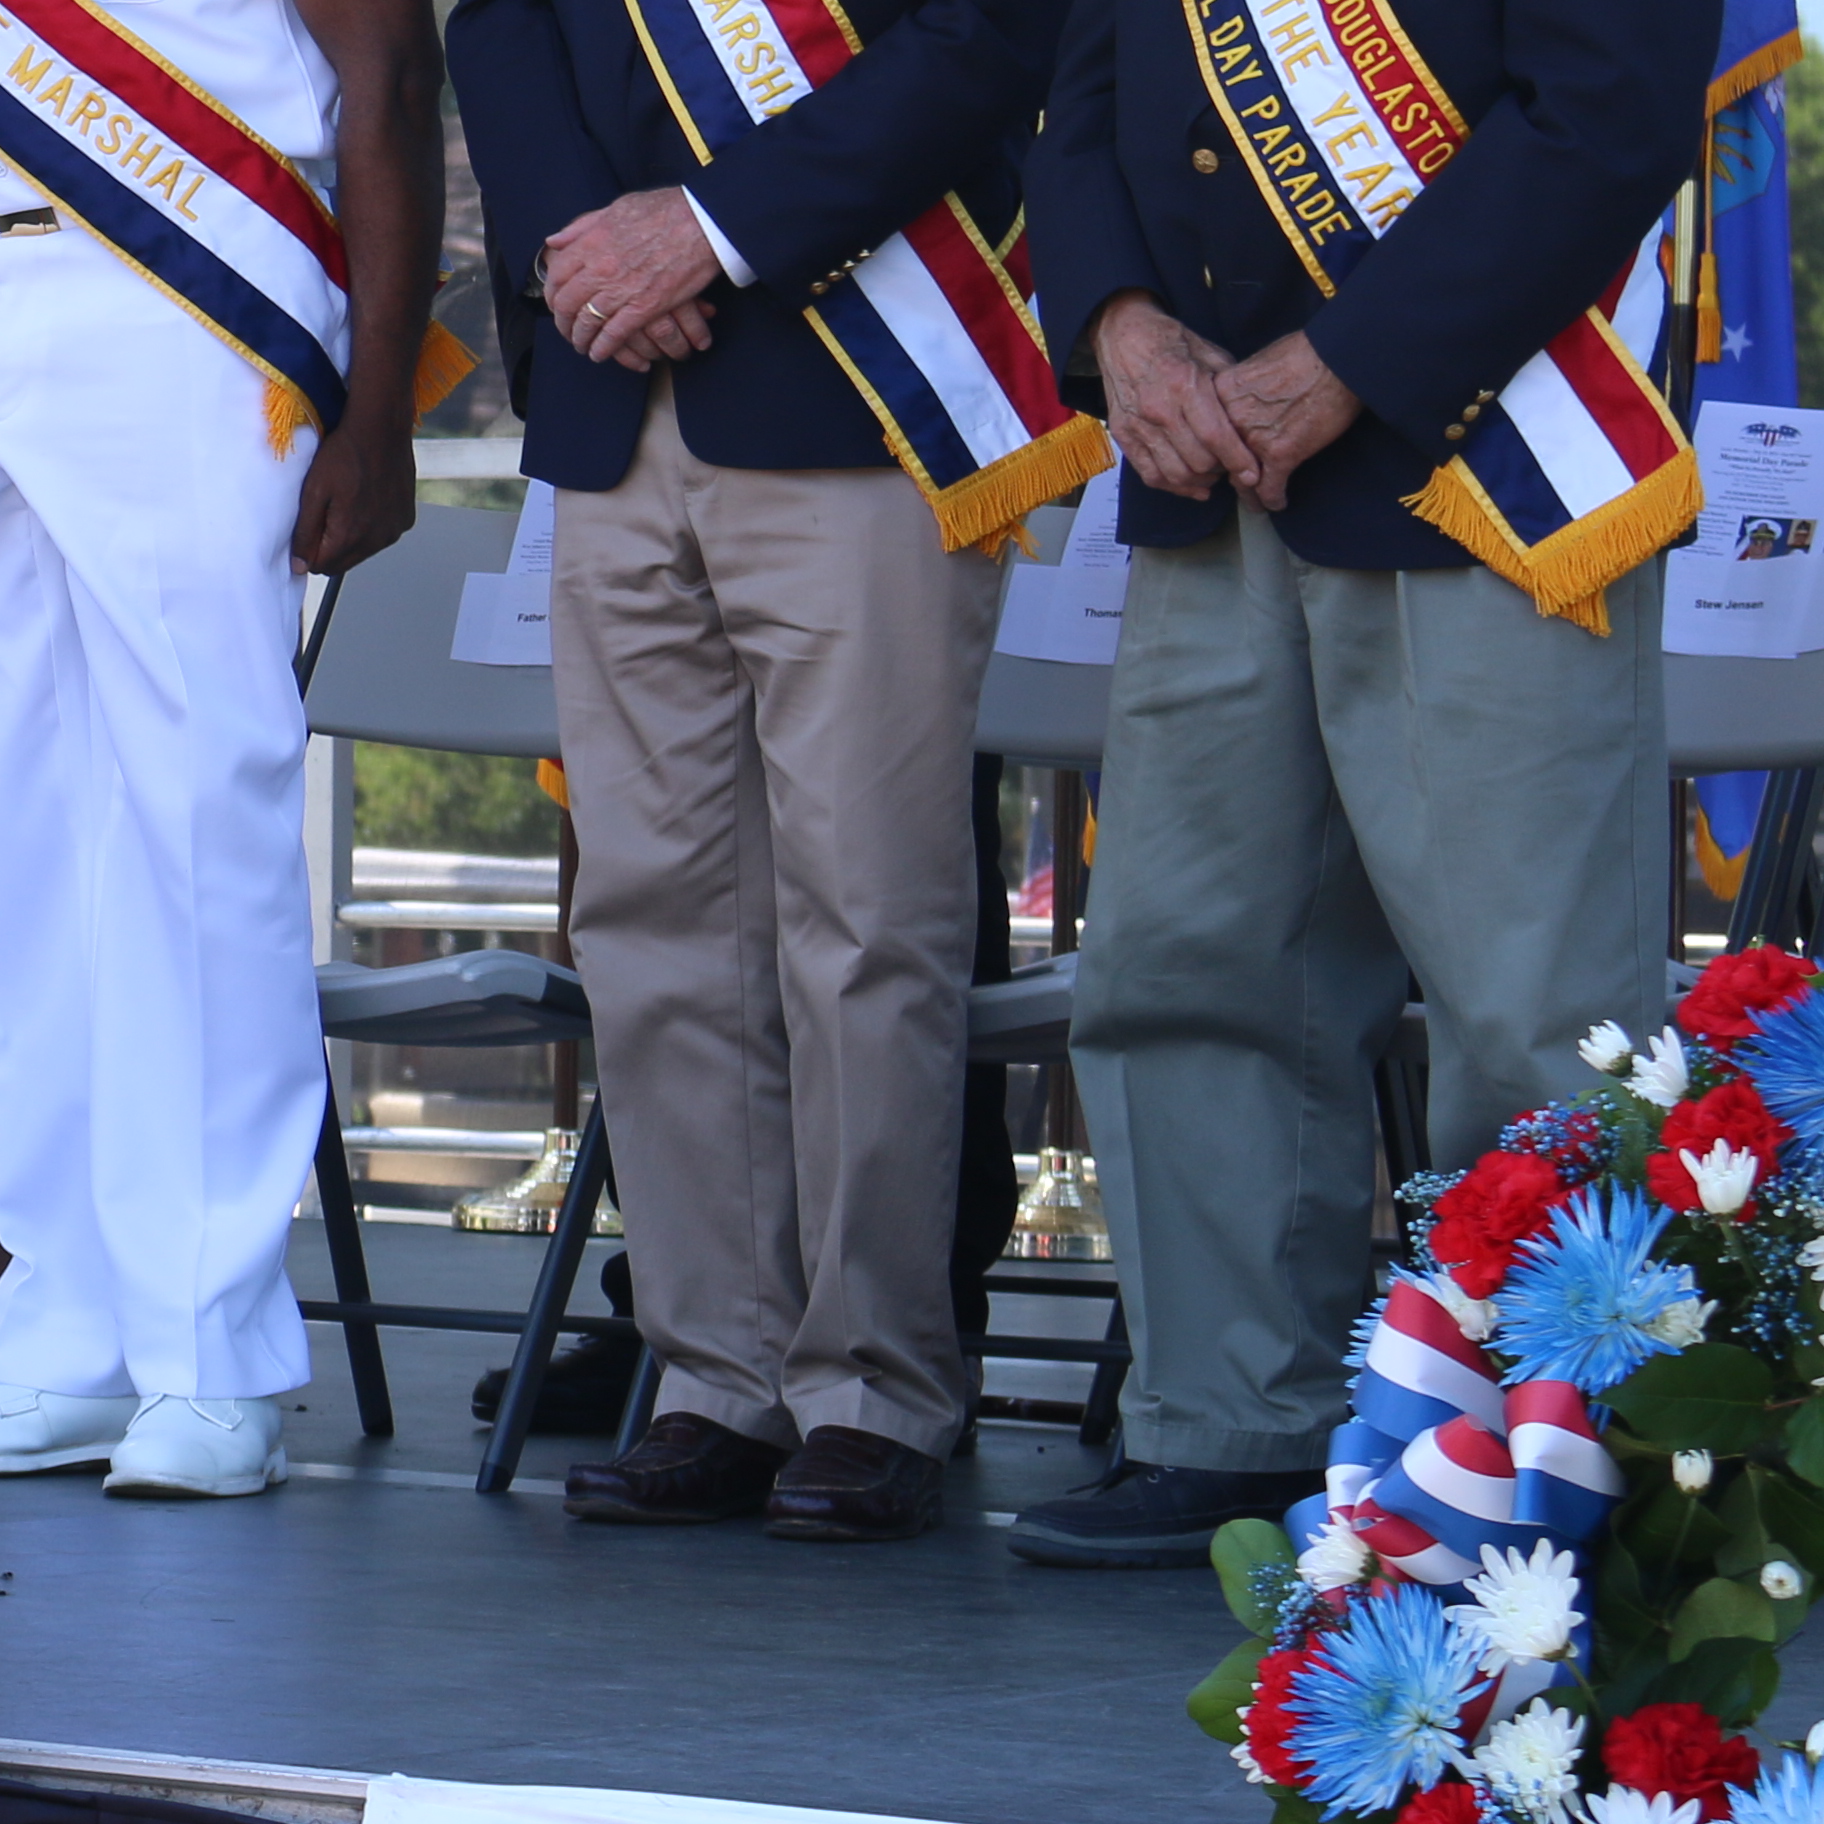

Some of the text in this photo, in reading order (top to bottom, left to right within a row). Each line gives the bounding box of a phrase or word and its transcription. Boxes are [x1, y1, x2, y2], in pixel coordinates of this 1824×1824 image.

[7, 43, 207, 223] MARSHAL
[1211, 15, 1263, 87] DAY
[1241, 95, 1352, 248] PARADE
[1313, 92, 1415, 230] YEAR
[517, 613, 547, 622] Father
[1695, 598, 1764, 610] Stew Jensen
